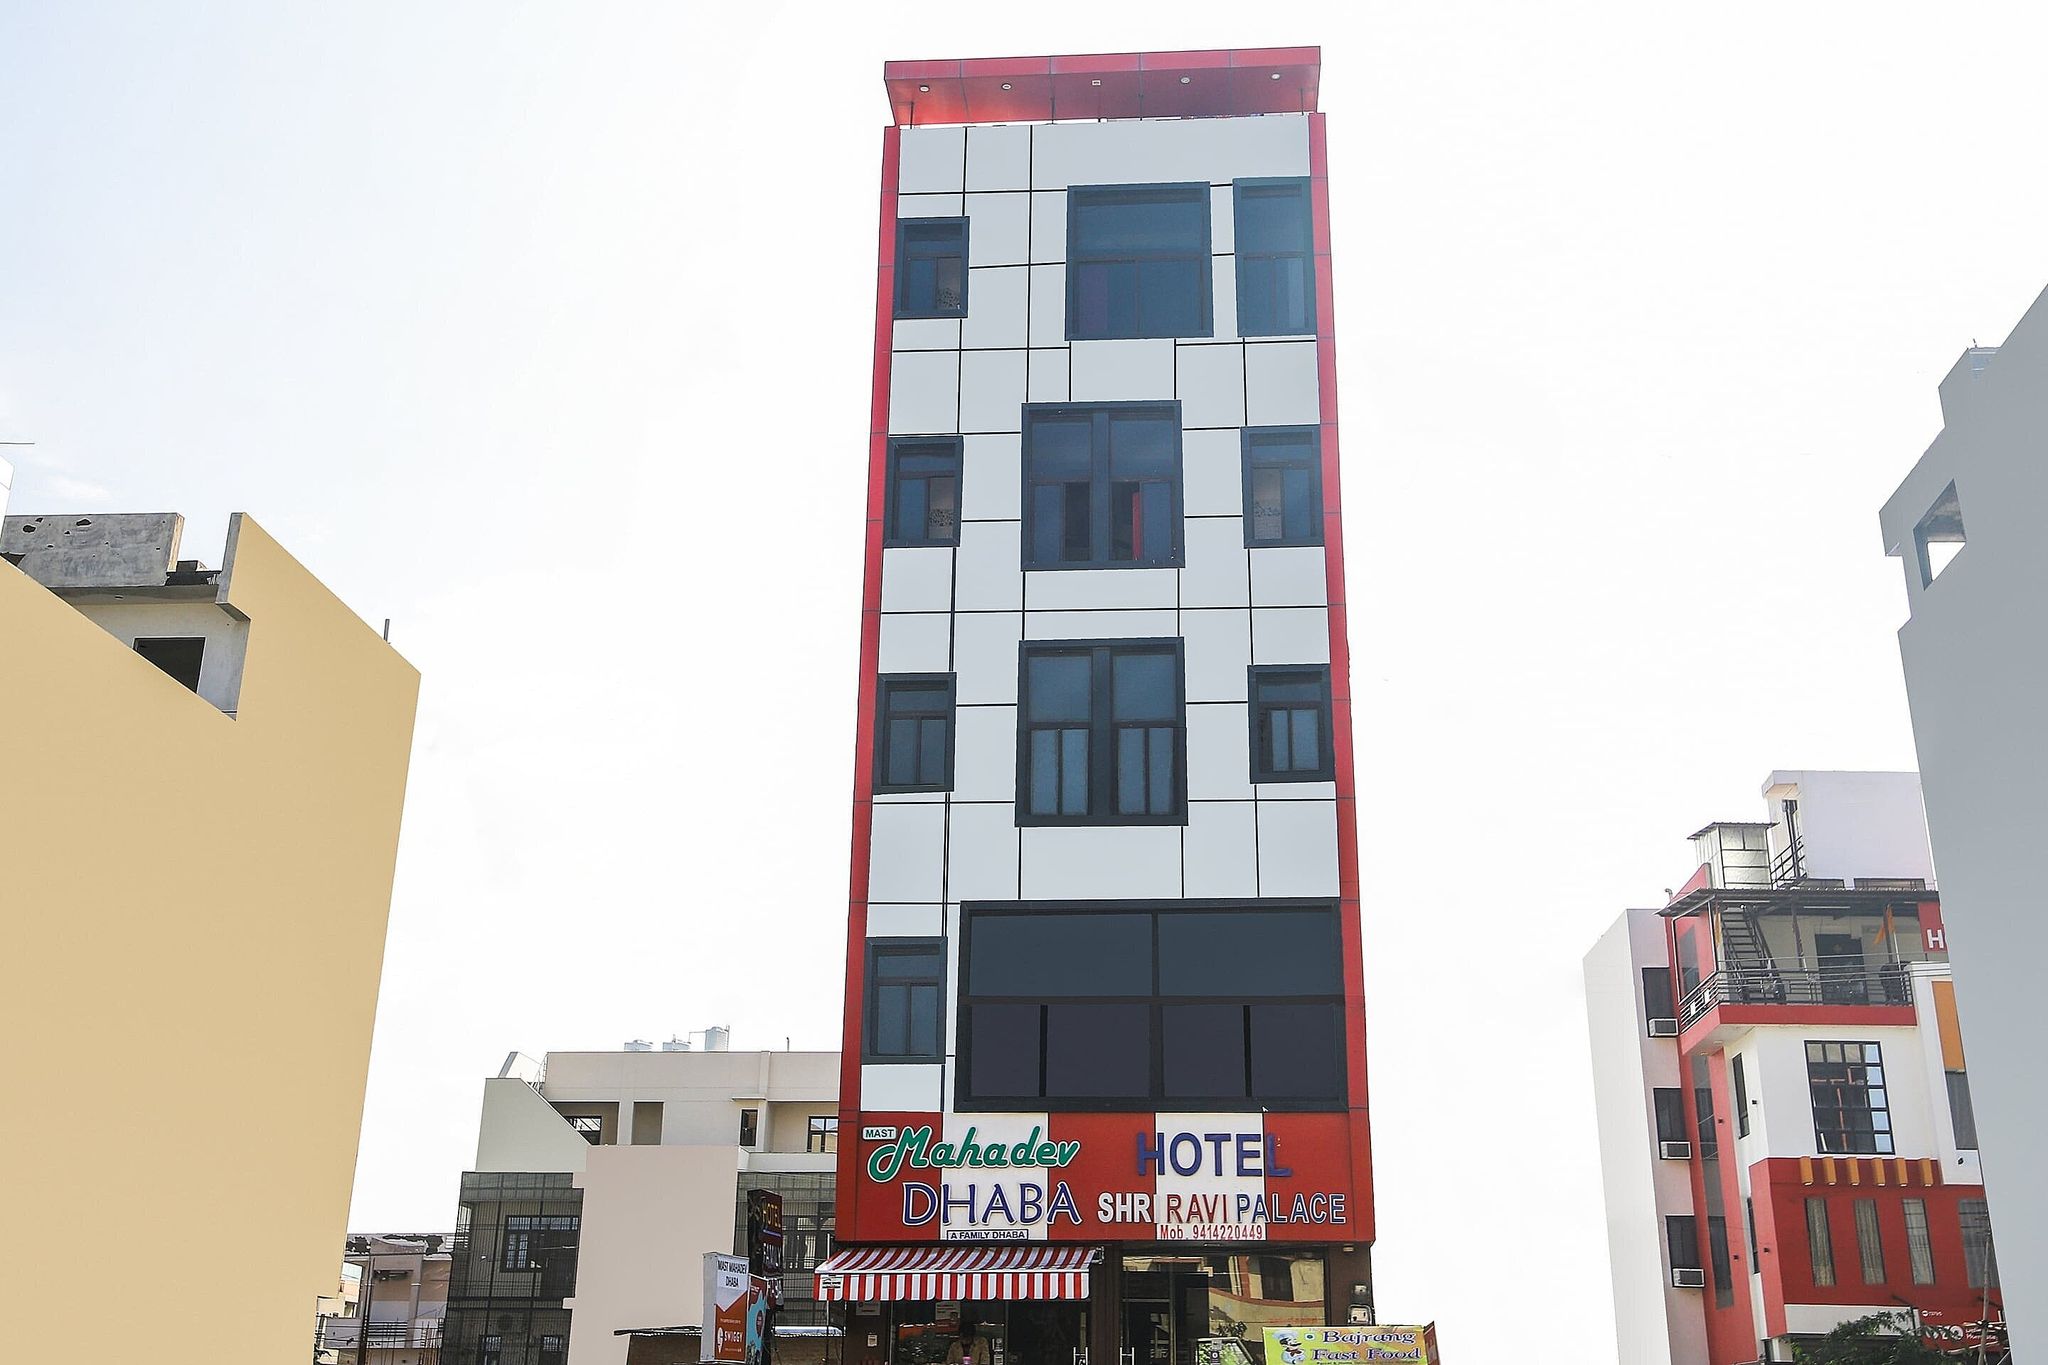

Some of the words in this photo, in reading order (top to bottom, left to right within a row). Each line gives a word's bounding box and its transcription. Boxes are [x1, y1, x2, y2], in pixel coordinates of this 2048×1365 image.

[865, 1129, 894, 1138] MAST
[867, 1126, 1081, 1183] Mahadev
[1137, 1131, 1293, 1177] HOTEL
[903, 1181, 1083, 1226] DHABA
[1097, 1192, 1160, 1224] SHRI
[1166, 1193, 1229, 1224] RAVI
[1236, 1193, 1347, 1224] PALACE
[951, 1232, 958, 1240] A
[960, 1231, 990, 1240] FAMILY
[992, 1231, 1025, 1239] DHABA
[1193, 1224, 1263, 1240] 9414220449
[725, 1276, 739, 1288] DHABA
[1322, 1330, 1416, 1345] Bajrang
[1312, 1348, 1360, 1361] Fast
[1366, 1346, 1421, 1361] Food
